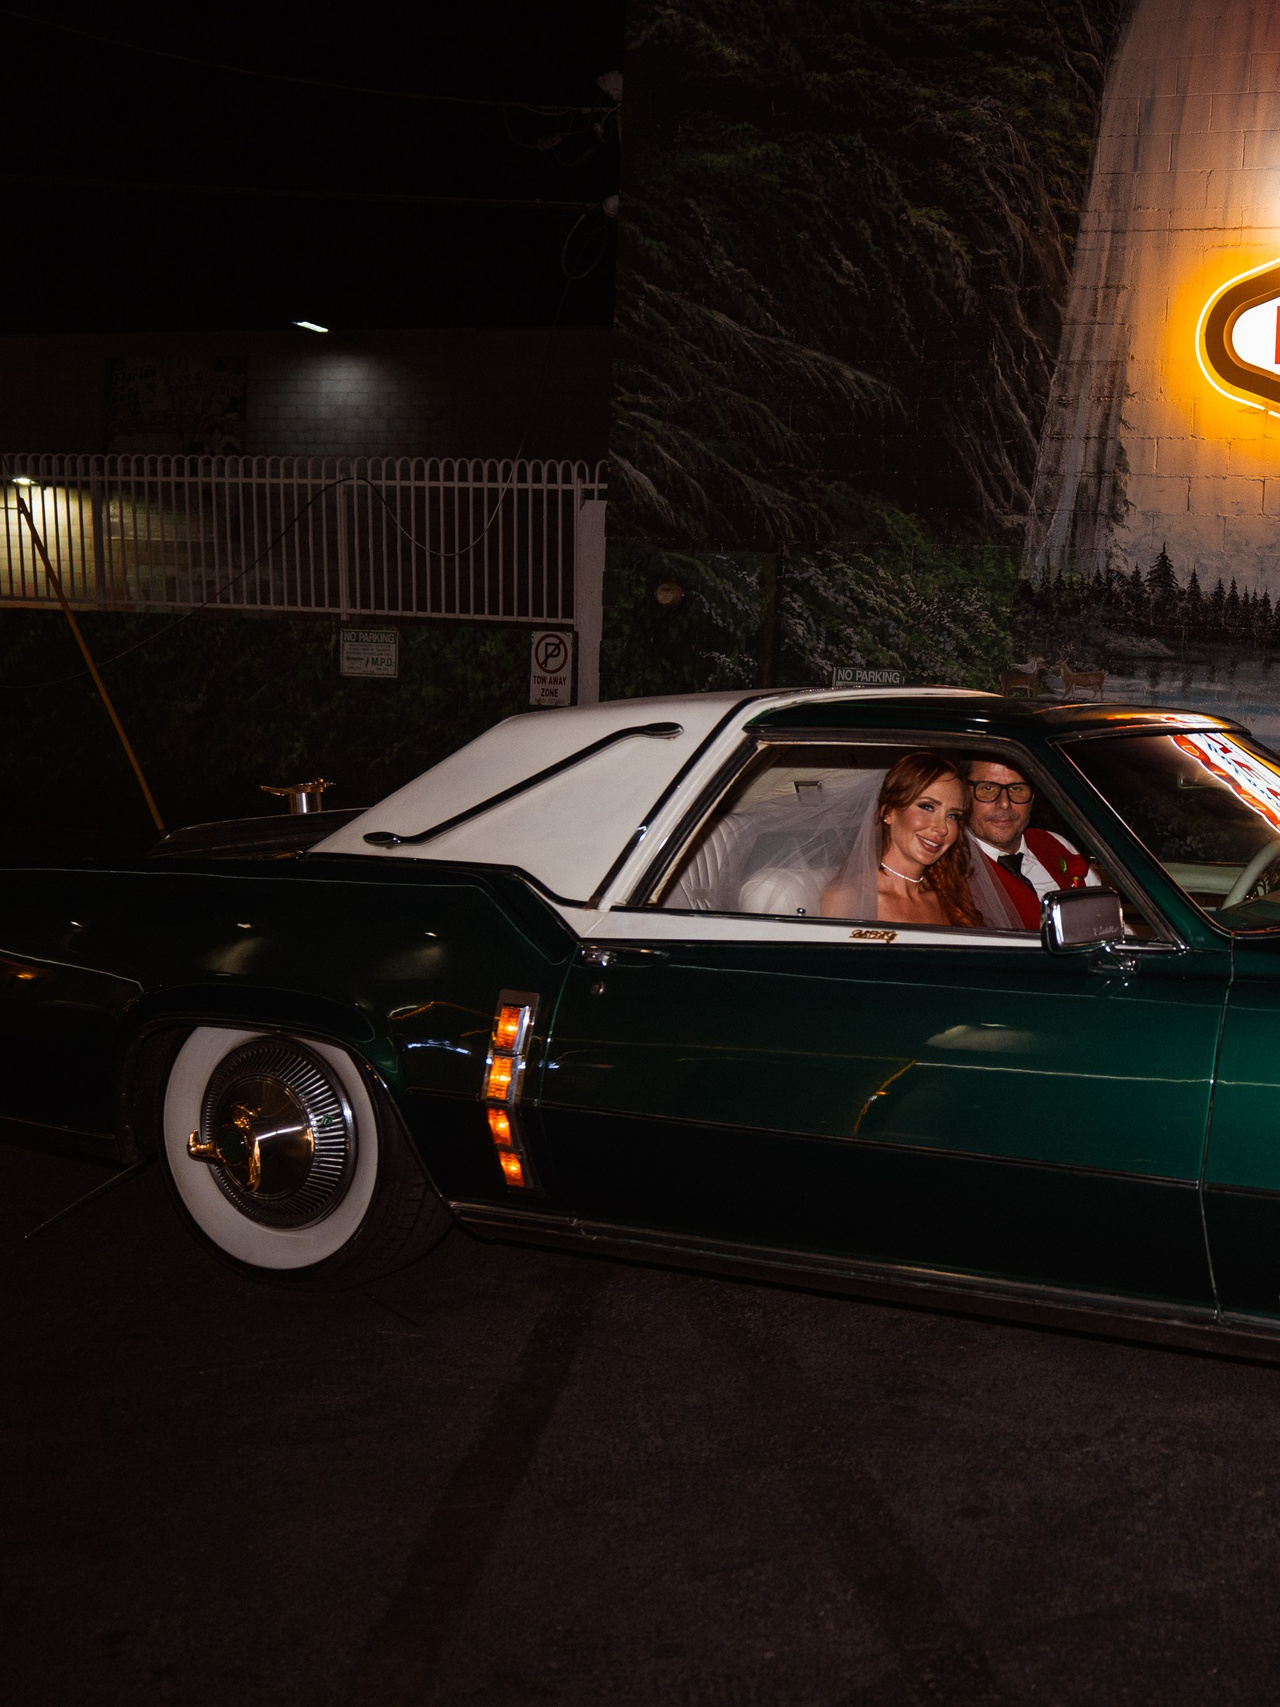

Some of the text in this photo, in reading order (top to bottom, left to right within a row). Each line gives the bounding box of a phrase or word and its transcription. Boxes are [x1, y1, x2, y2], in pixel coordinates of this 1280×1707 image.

[344, 631, 395, 643] NO PARKING
[532, 675, 567, 686] TOW AWAY
[837, 668, 900, 684] NO PARKING
[540, 688, 558, 698] ZONE
